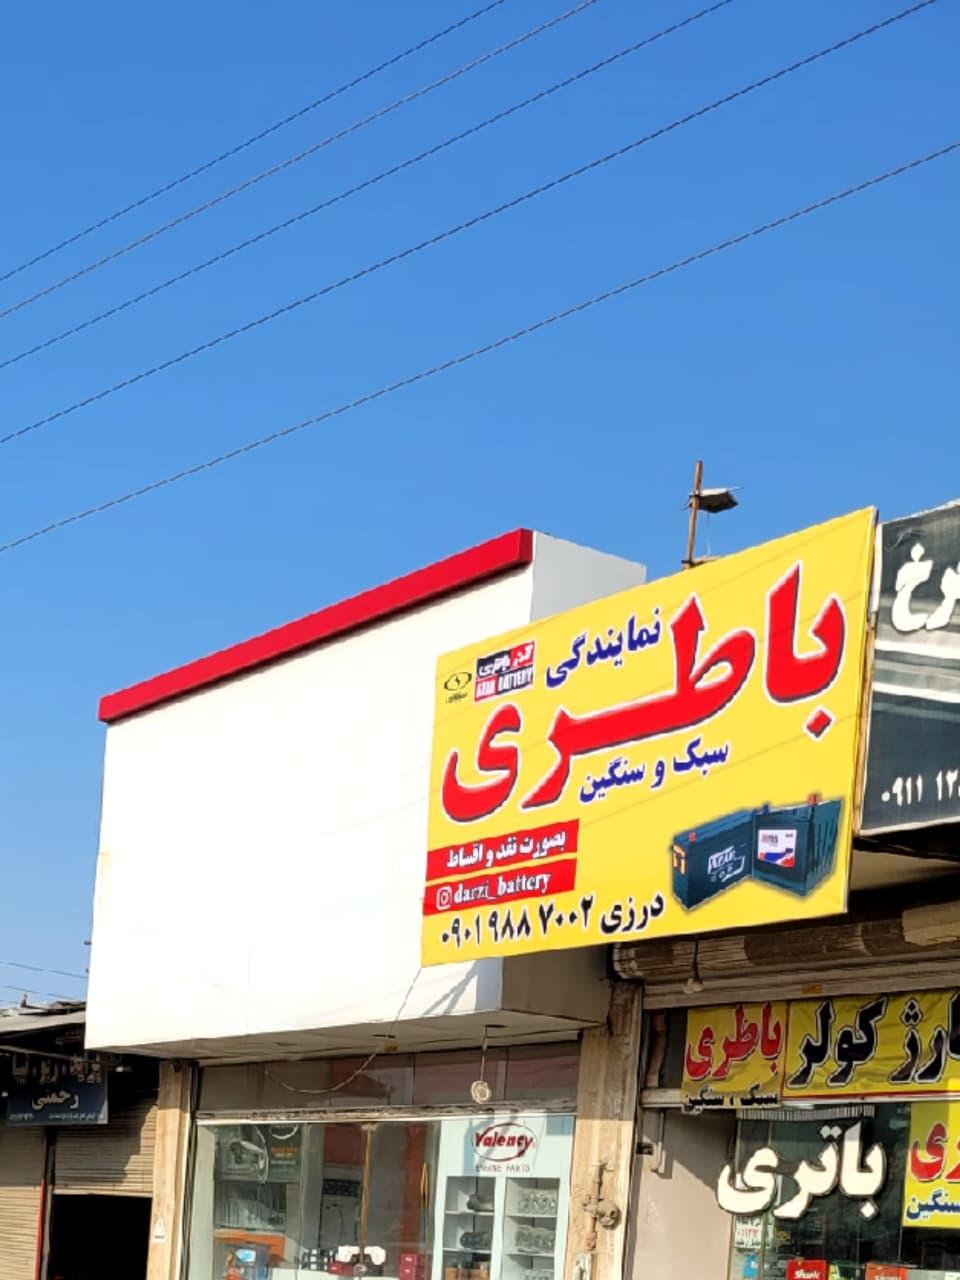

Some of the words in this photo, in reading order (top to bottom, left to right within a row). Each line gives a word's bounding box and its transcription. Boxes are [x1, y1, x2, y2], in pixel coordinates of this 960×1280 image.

[545, 607, 661, 688] نمایندگی
[441, 561, 846, 823] باطری
[498, 668, 533, 691] BATTERY
[652, 760, 665, 788] و
[673, 738, 729, 777] سبک
[579, 756, 645, 803] سنگین
[881, 773, 923, 806] ۰۹۱۱
[446, 842, 484, 868] اقساط
[486, 849, 494, 867] و
[496, 836, 517, 859] نقد
[520, 831, 567, 859] بصورت
[453, 873, 551, 905] darzi_battery
[441, 914, 481, 948] ۰۹۰۱
[488, 908, 531, 942] ۹۸۸
[537, 895, 593, 935] ۷۰۰۲
[600, 894, 665, 934] درزی
[685, 1002, 782, 1080] باطری
[787, 997, 889, 1088] کولر
[716, 1121, 886, 1219] باتری
